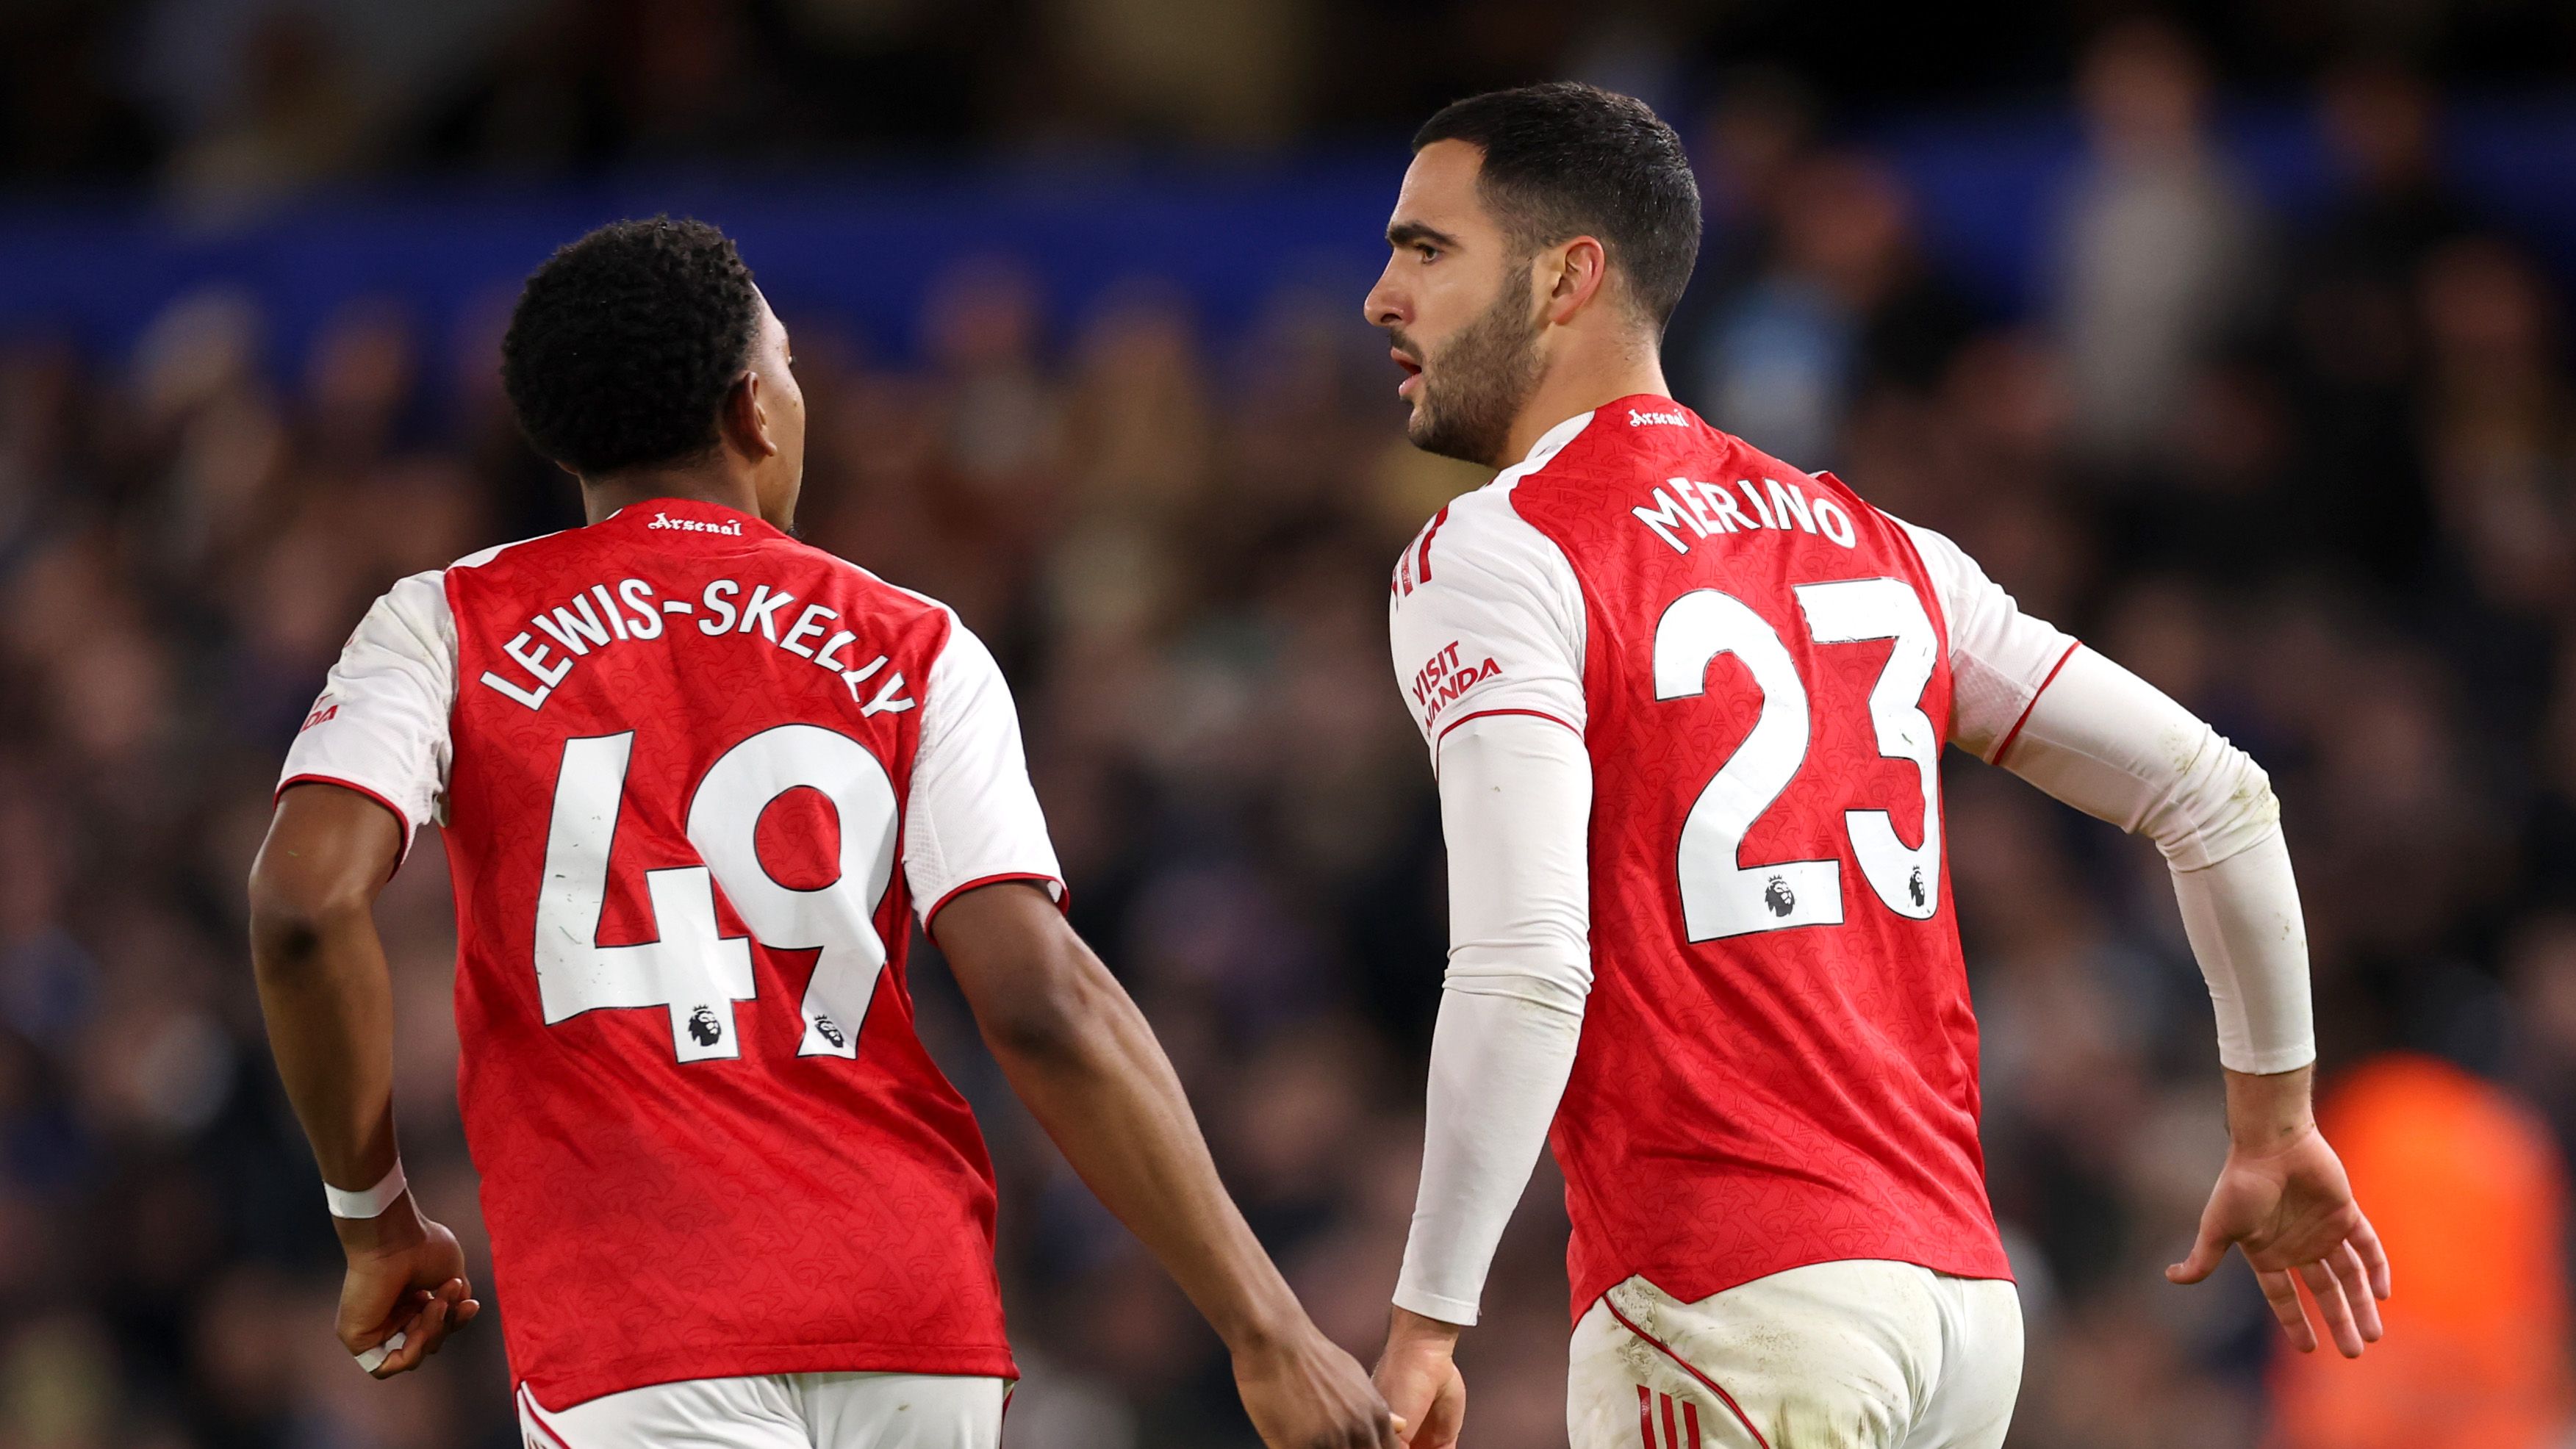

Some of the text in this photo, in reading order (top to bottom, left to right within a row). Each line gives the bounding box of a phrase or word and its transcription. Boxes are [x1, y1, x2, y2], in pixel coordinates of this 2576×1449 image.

[1628, 409, 1689, 427] Arsenal
[647, 512, 742, 536] Arsenal
[1632, 476, 1856, 555] MERINO
[480, 578, 916, 718] LEWIS-SKELLY
[1413, 640, 1459, 706] VISIT
[1653, 578, 1939, 943] 23
[535, 724, 899, 1063] 49
